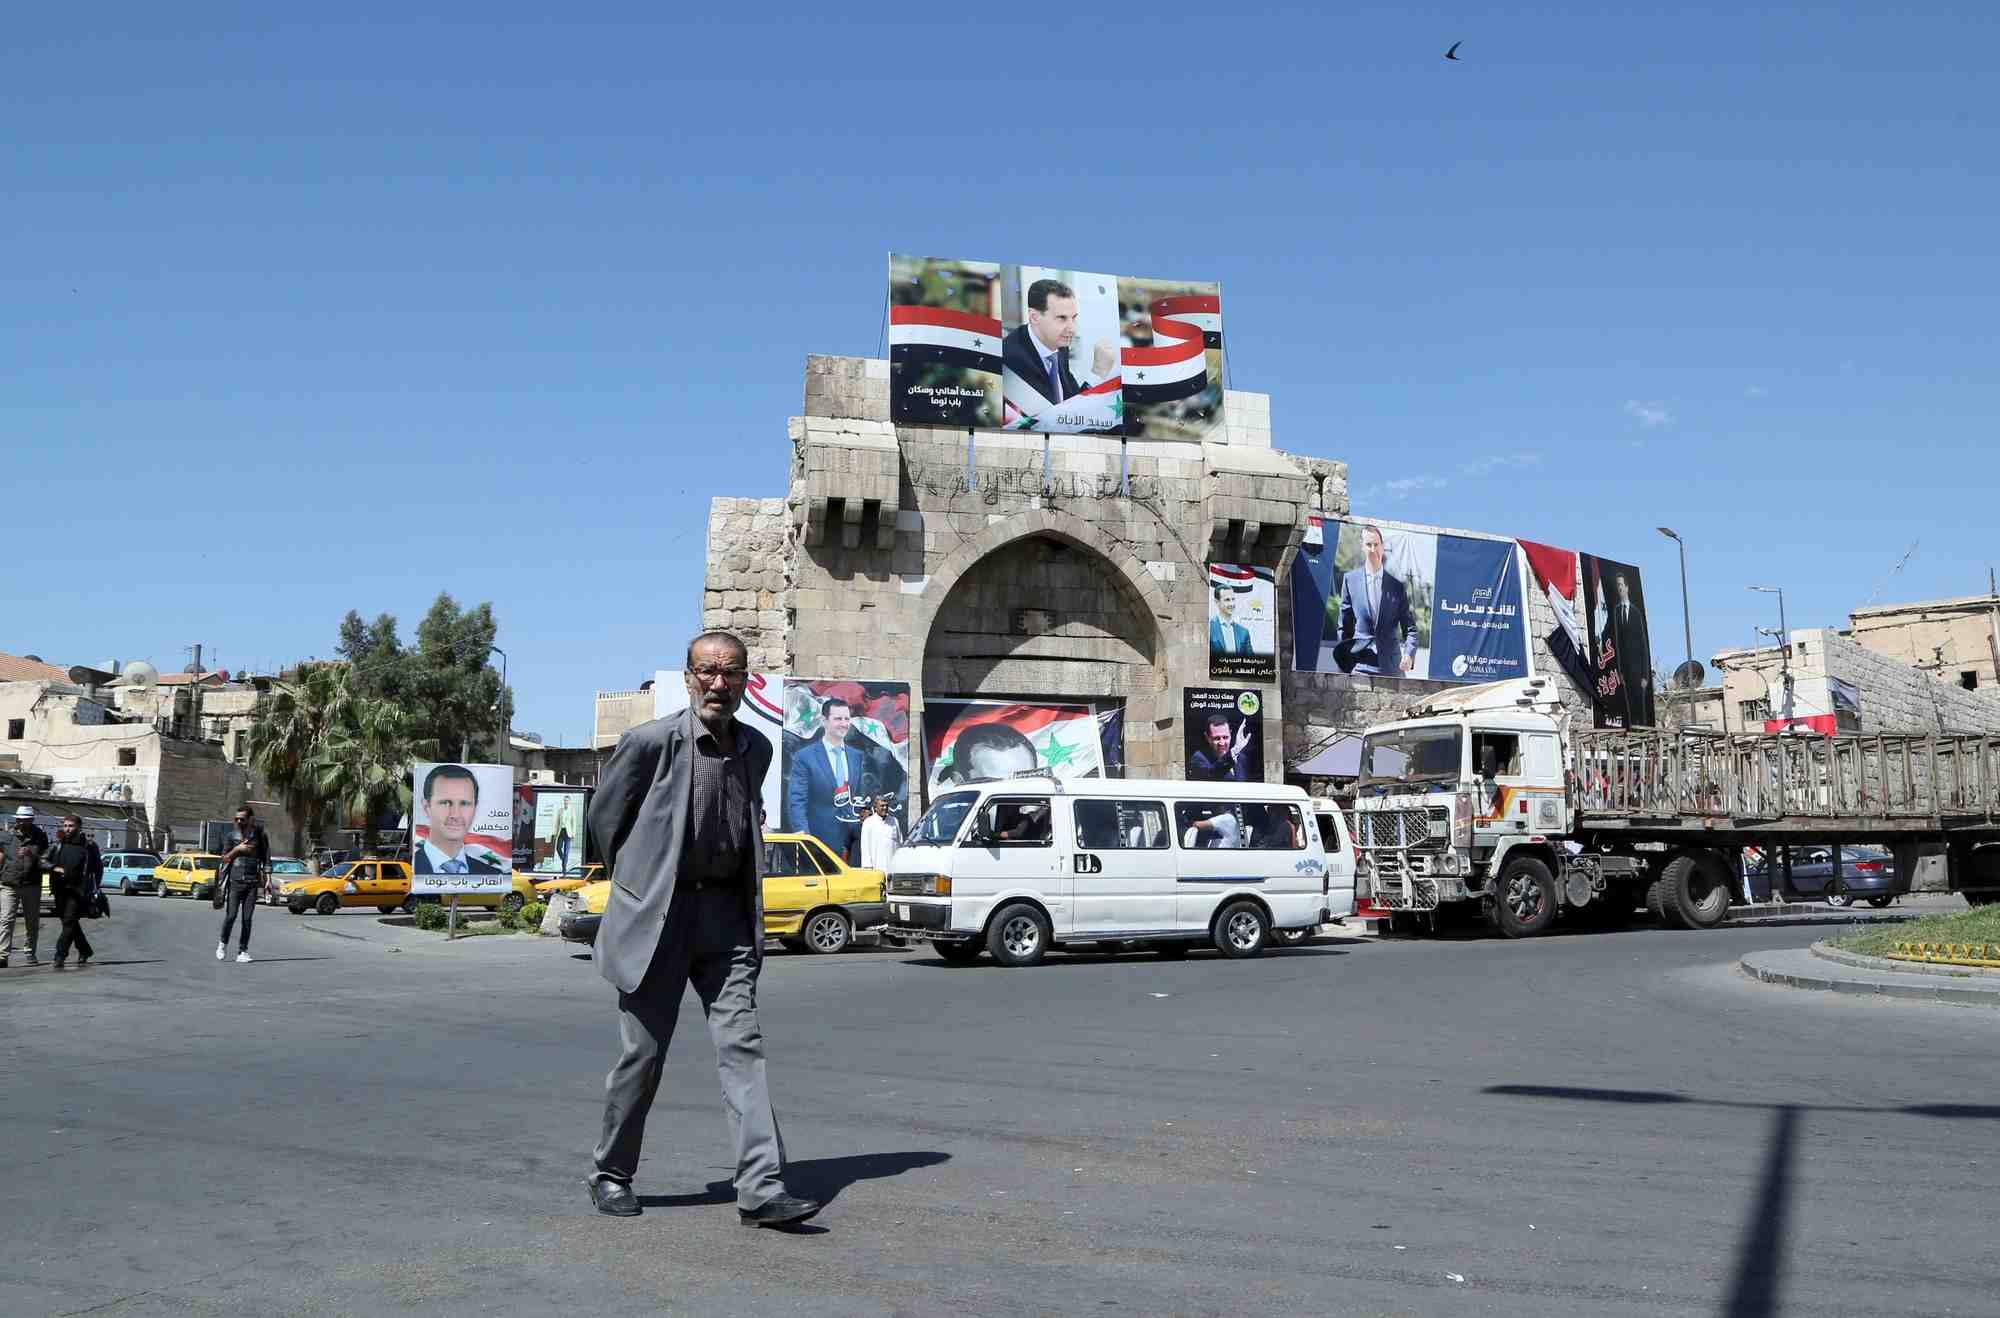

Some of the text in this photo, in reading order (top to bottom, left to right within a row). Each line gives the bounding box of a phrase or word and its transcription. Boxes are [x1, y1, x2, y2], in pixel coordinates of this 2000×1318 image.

[907, 384, 984, 398] تقدمة أهالي وسكان
[930, 396, 961, 408] باب توما
[1441, 599, 1516, 617] لقائد سورية
[1235, 666, 1256, 675] العهد
[487, 807, 510, 818] معك
[472, 823, 510, 833] مكملين
[424, 877, 449, 888] توما
[450, 877, 469, 888] باب
